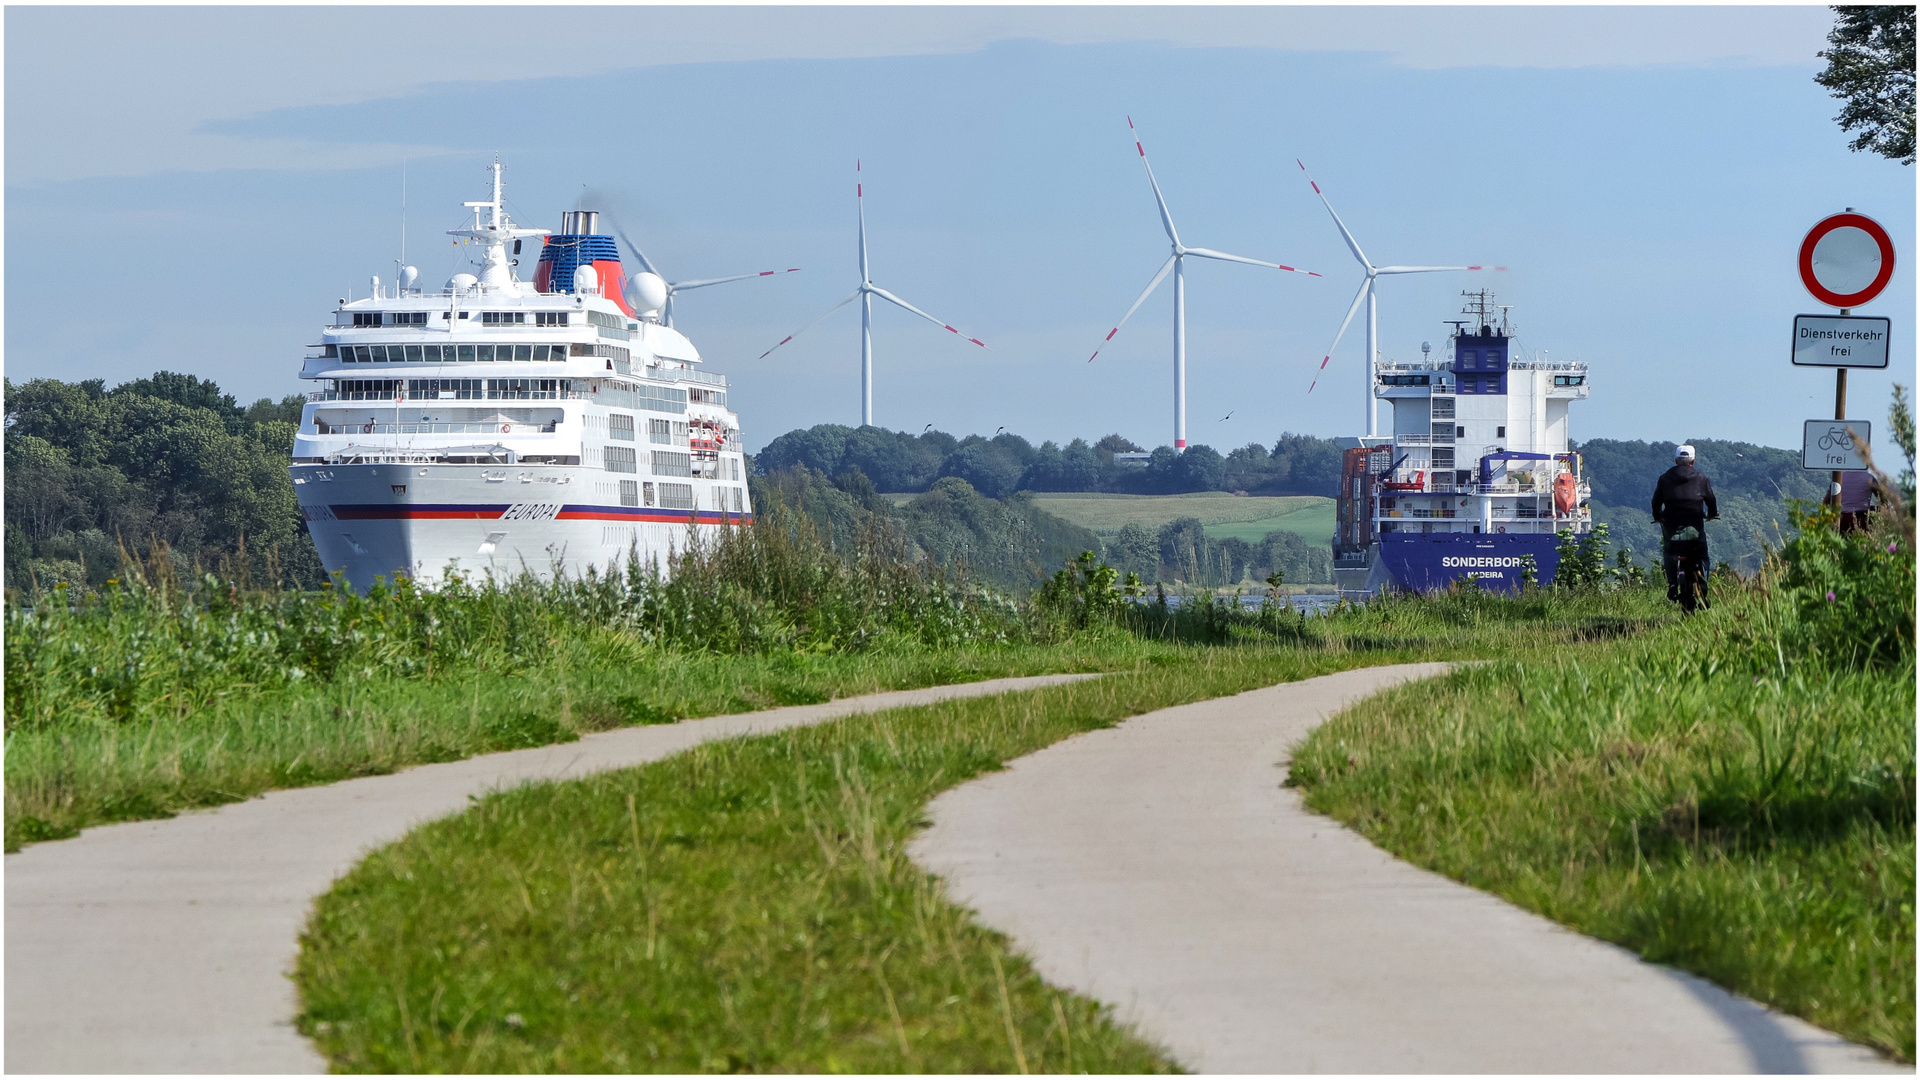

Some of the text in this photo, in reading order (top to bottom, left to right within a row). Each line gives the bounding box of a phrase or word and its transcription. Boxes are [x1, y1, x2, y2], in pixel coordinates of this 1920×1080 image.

[1800, 327, 1883, 341] Dienstverkehr
[1831, 345, 1851, 356] frei
[1826, 453, 1847, 464] frei
[504, 503, 559, 520] EUROPA
[1467, 571, 1504, 579] MADEIRA
